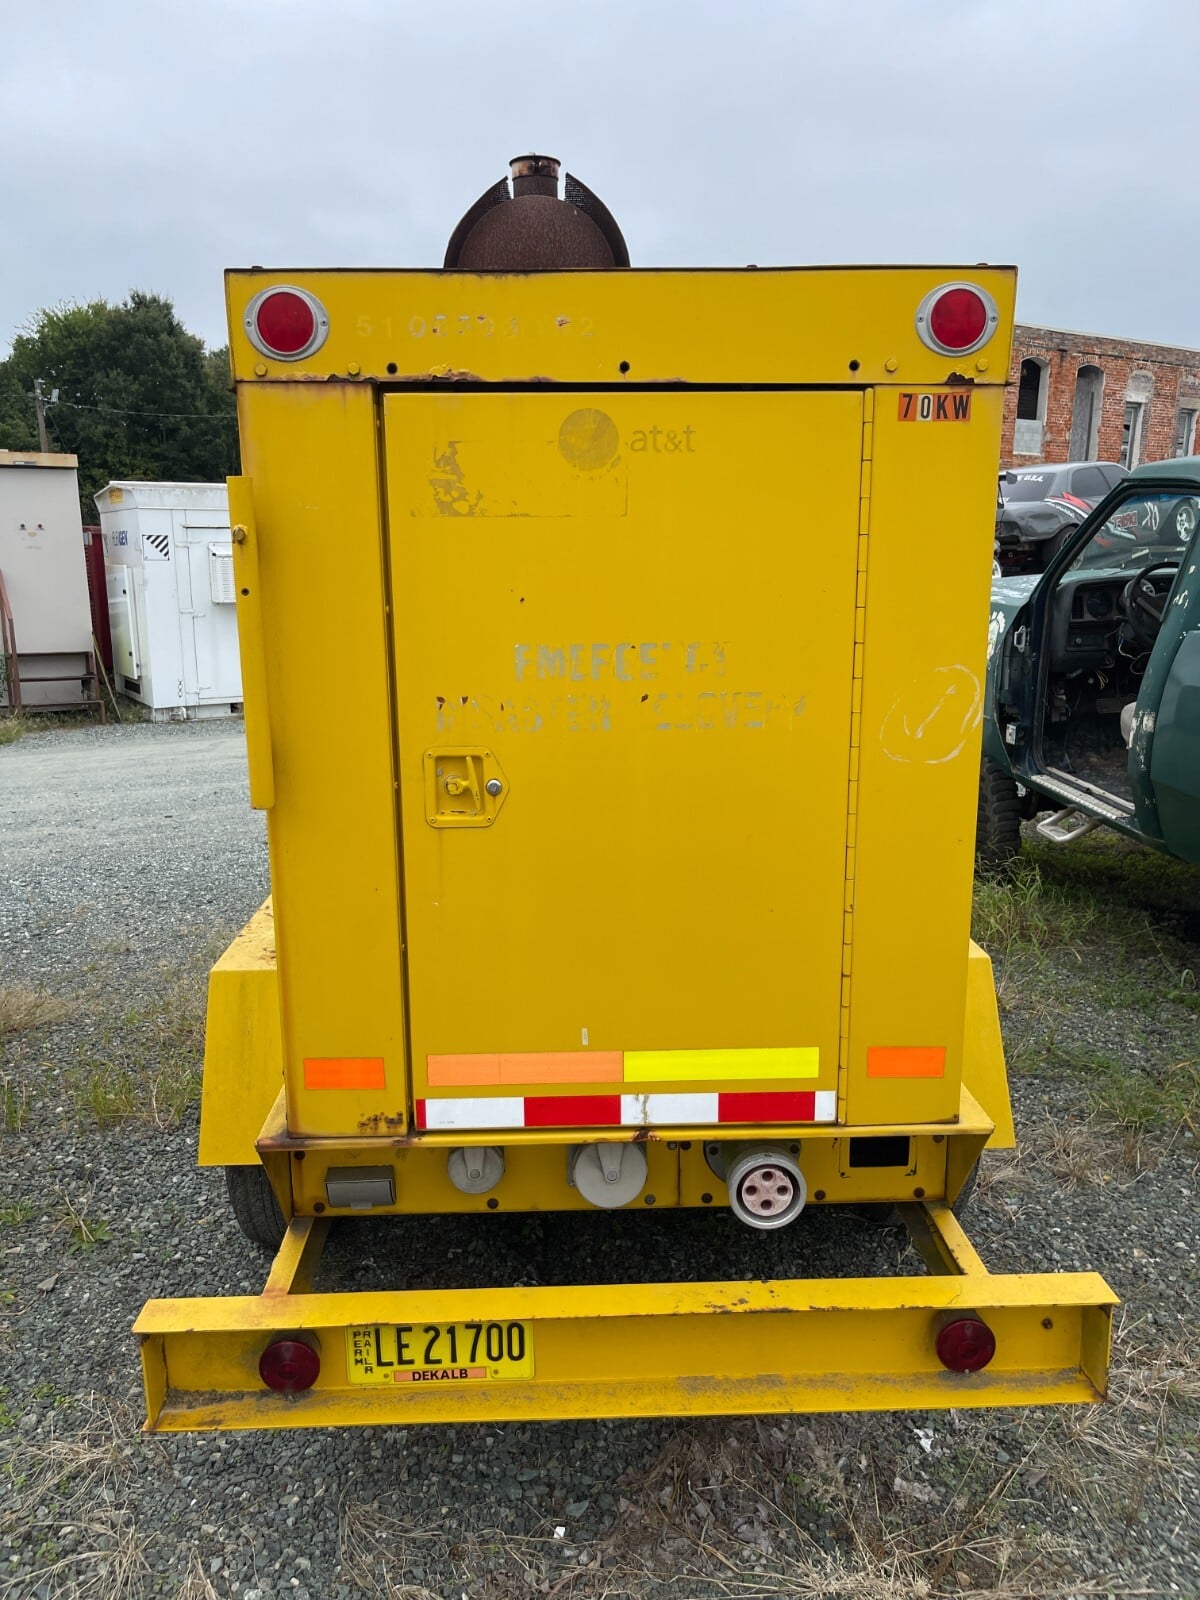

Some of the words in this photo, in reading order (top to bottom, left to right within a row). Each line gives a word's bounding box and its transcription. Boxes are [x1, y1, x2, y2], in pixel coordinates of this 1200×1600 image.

[902, 393, 970, 420] 70KW
[630, 425, 696, 453] at&t
[353, 1331, 363, 1366] PERM
[411, 1368, 468, 1382] DEKALB
